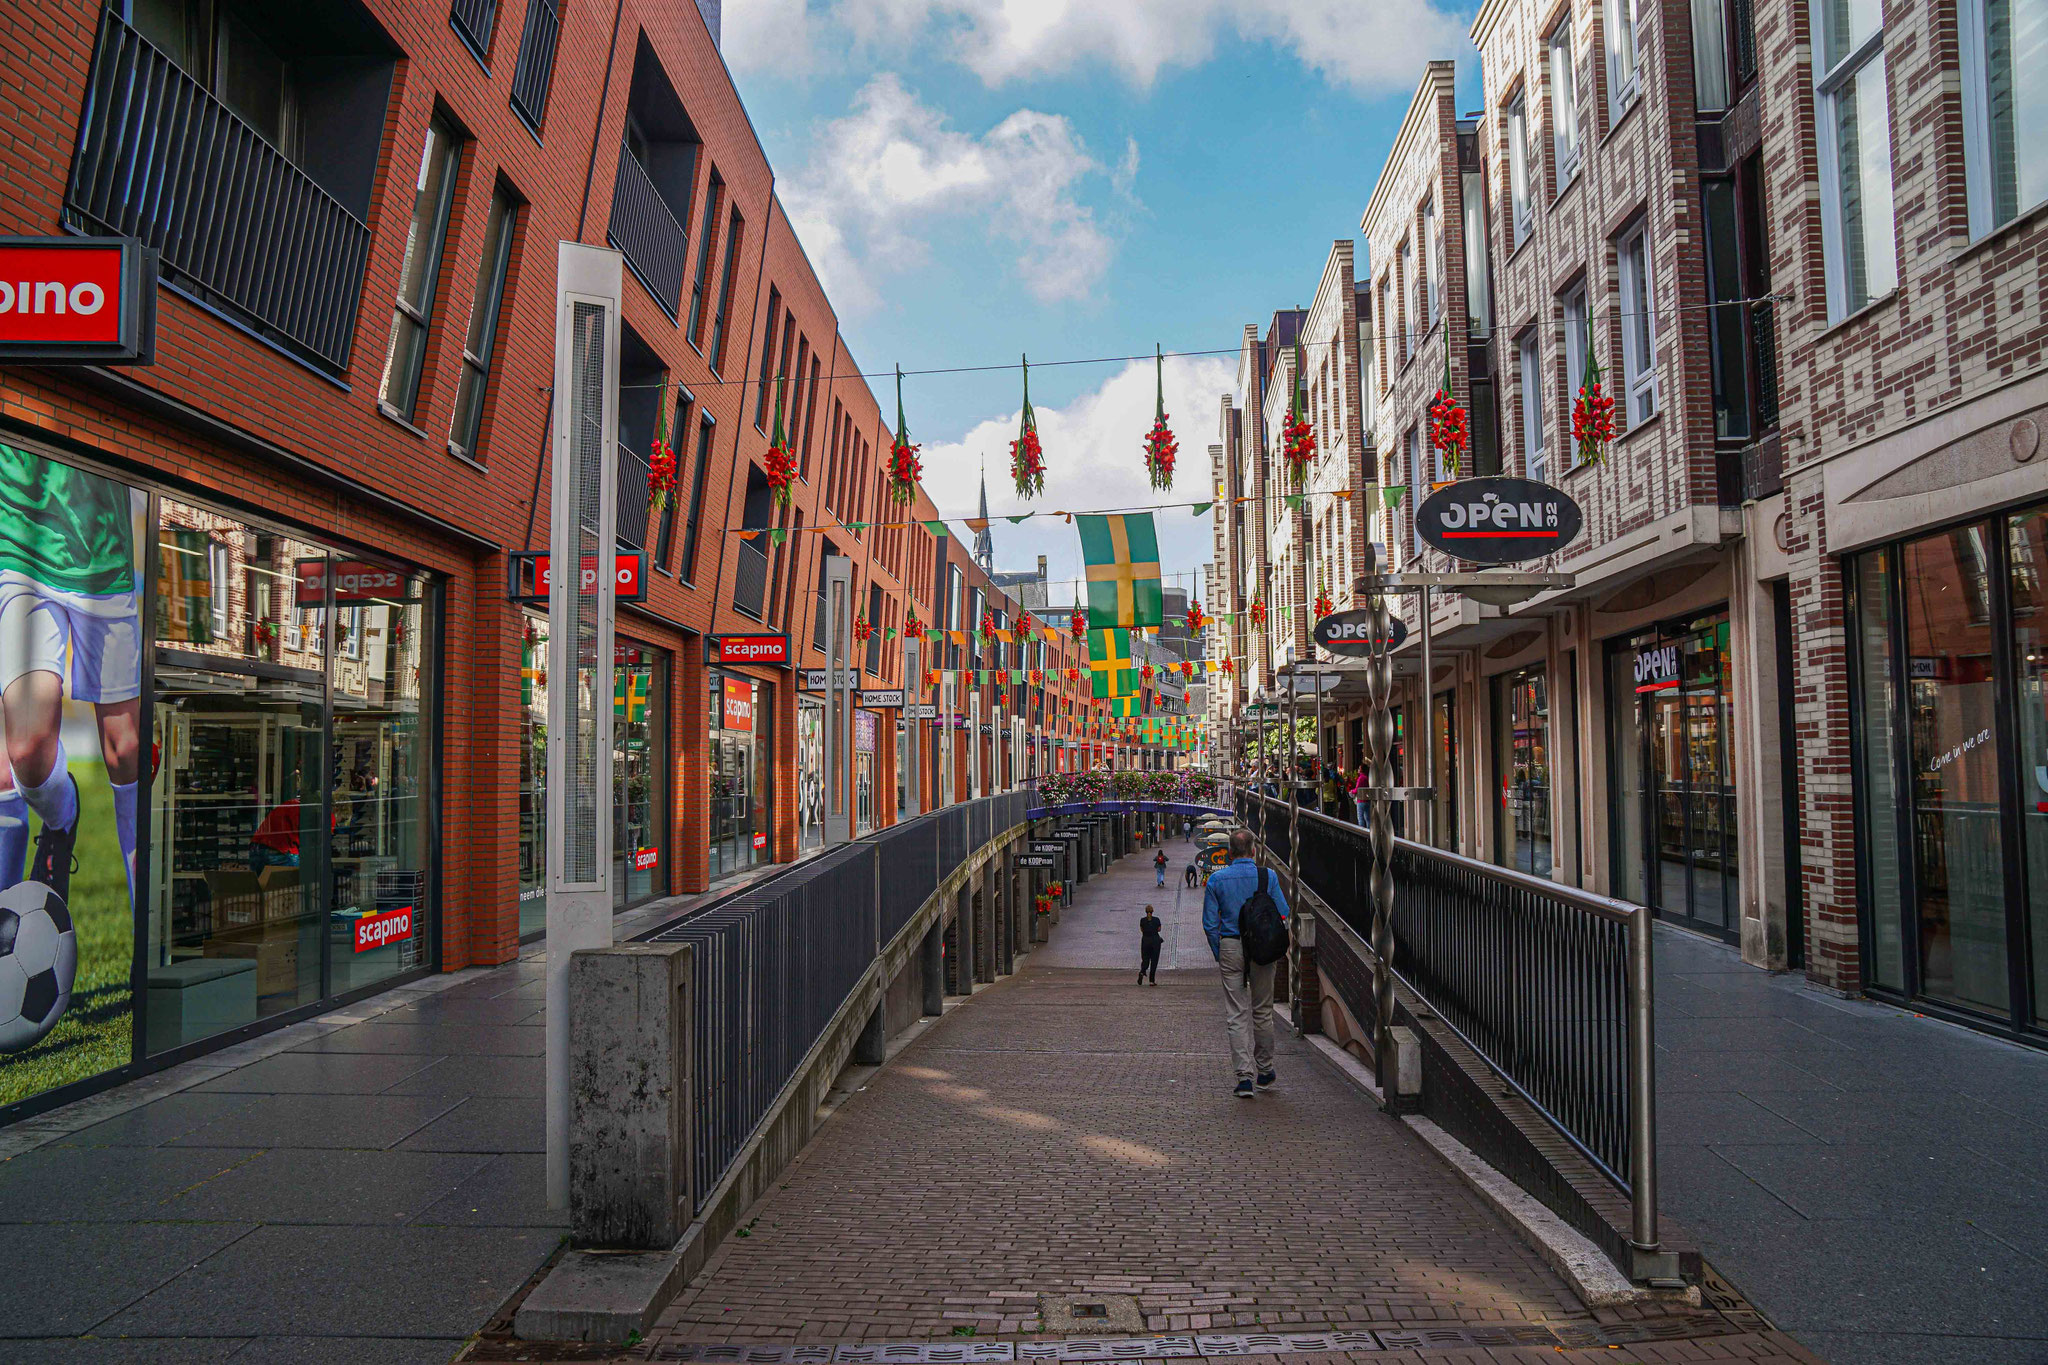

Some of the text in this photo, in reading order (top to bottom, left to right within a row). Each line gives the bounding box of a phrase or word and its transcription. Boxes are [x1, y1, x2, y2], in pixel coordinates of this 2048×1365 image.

[1546, 502, 1558, 527] 32
[725, 644, 783, 659] scapino
[810, 675, 855, 686] HOM STOK
[864, 694, 901, 703] HOME STOCK
[725, 697, 751, 724] scapino
[1930, 728, 1991, 771] Come in we are
[637, 851, 657, 869] scapino
[1020, 857, 1053, 865] de KOOPman
[520, 886, 545, 902] neem die
[359, 914, 409, 946] scapino
